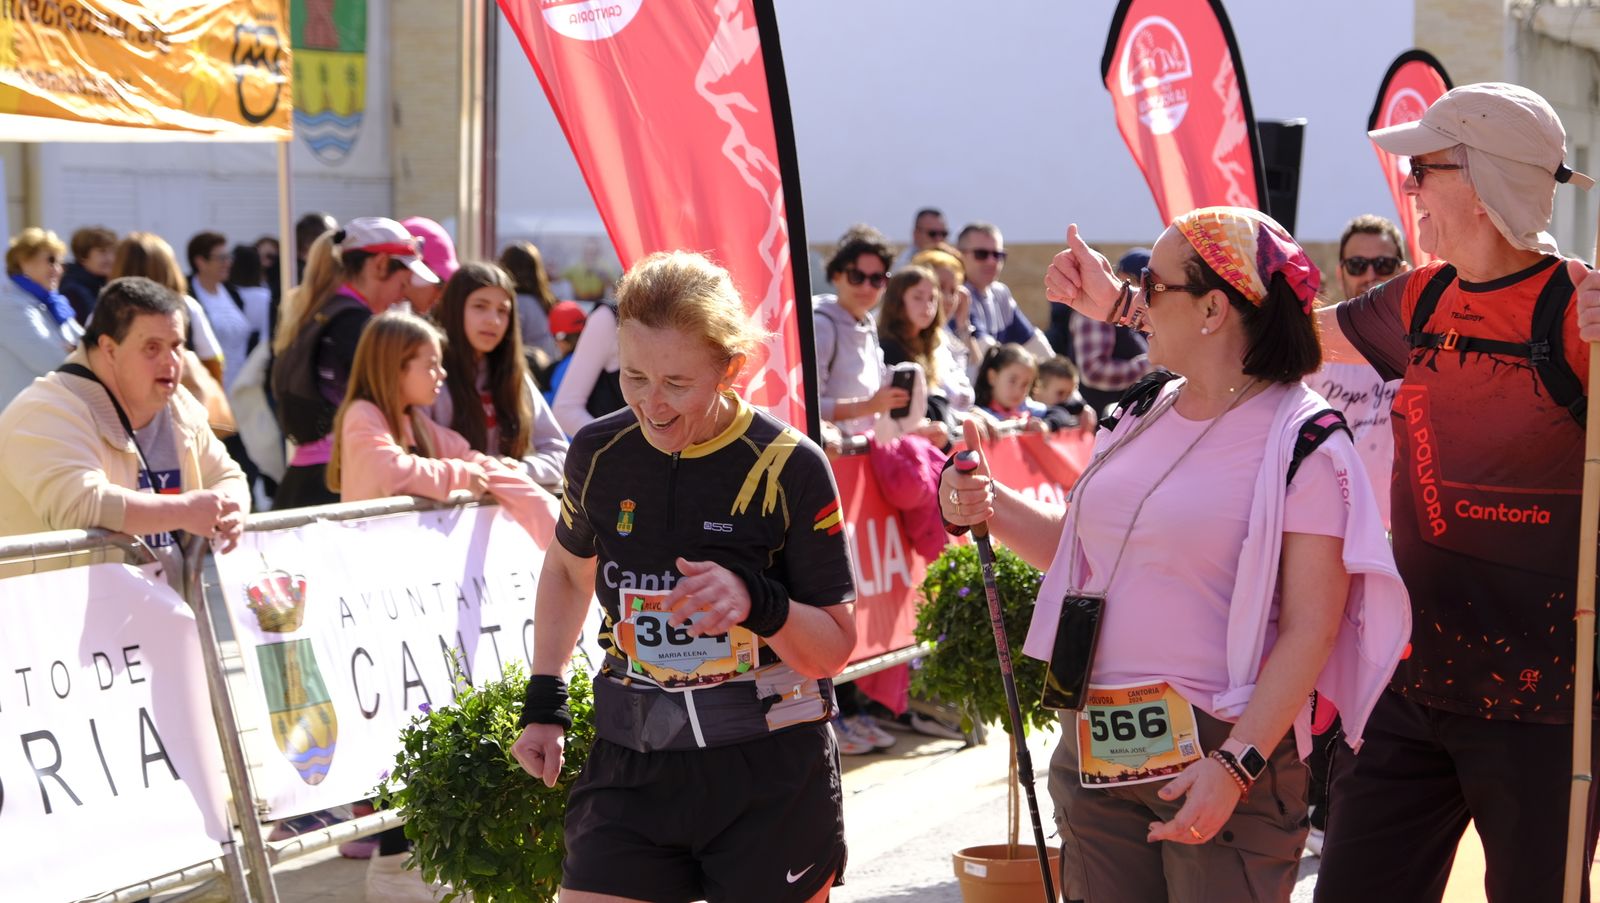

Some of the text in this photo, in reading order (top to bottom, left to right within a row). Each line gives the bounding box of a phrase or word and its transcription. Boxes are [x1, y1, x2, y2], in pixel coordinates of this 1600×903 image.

[1322, 380, 1368, 412] Pepe
[1407, 394, 1447, 538] LA POLVORA
[1455, 500, 1551, 524] Cantoria
[92, 645, 146, 691] DE
[658, 650, 707, 660] MARIA ELENA
[0, 660, 71, 710] TO
[1127, 688, 1160, 697] CANTORIA
[1090, 706, 1167, 742] 566
[0, 706, 182, 815] RIA
